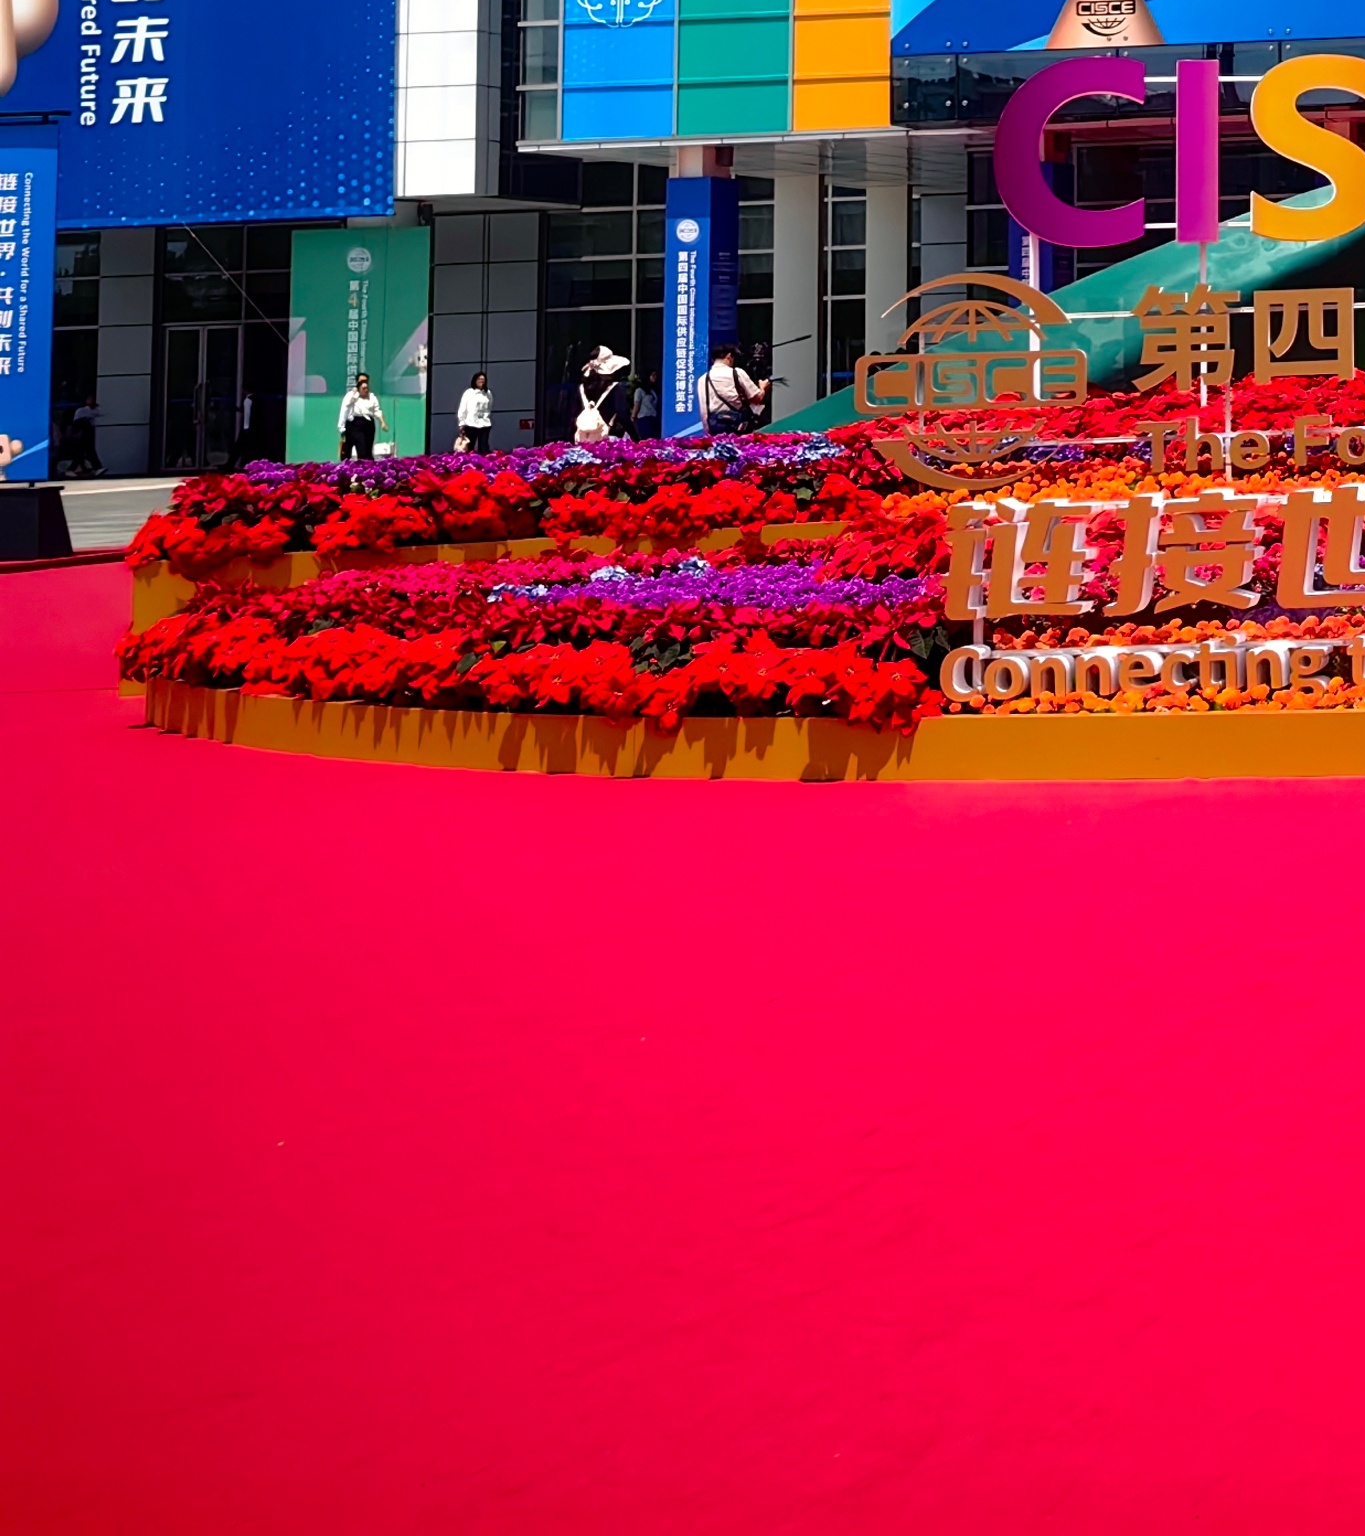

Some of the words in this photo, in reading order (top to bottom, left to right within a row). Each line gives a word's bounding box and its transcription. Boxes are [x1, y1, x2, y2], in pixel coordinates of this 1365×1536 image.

[1077, 0, 1135, 15] CISCE
[80, 44, 101, 126] Future
[21, 172, 34, 227] Connecting
[21, 229, 31, 245] the
[20, 246, 31, 277] World
[19, 278, 30, 293] for
[18, 304, 29, 338] Shared
[17, 340, 28, 373] Future
[1136, 416, 1271, 474] The
[940, 632, 1333, 702] Connecting
